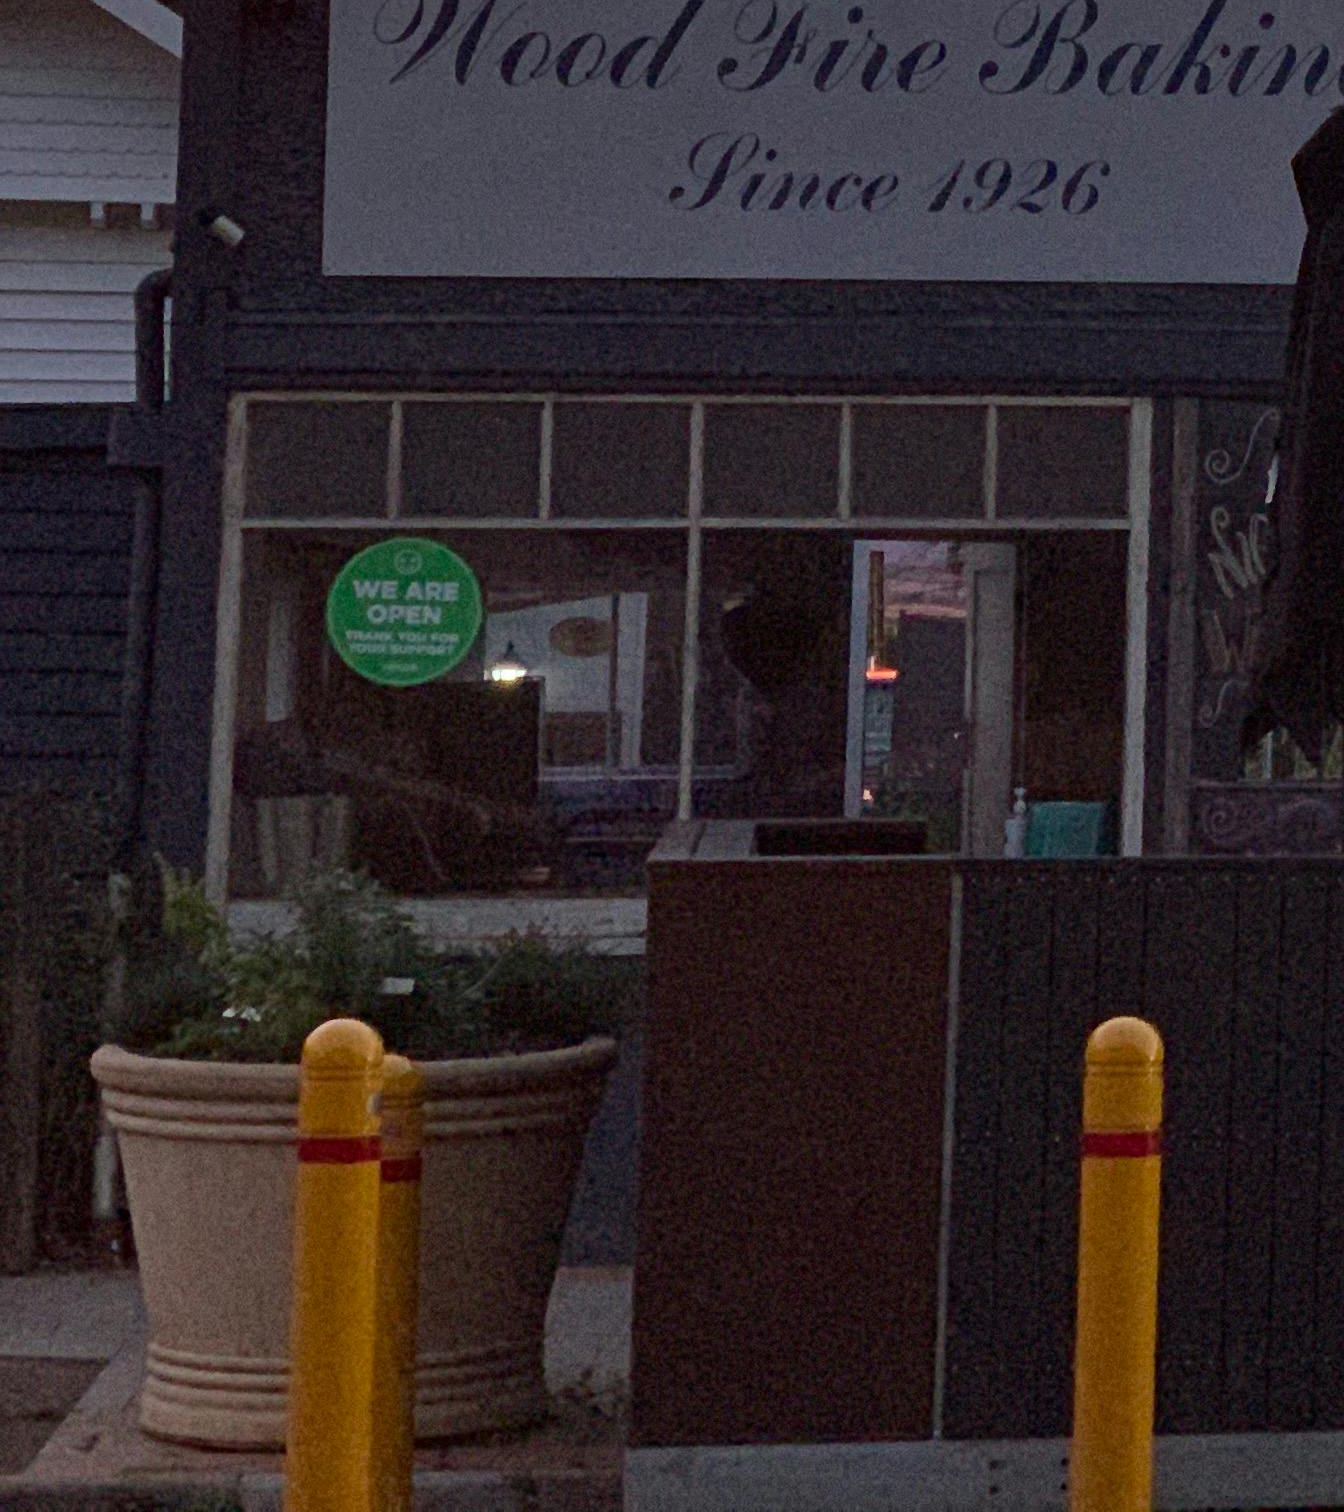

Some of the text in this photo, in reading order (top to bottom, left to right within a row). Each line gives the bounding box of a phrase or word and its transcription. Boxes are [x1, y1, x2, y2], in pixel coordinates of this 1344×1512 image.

[668, 131, 1109, 216] Since 1926
[353, 580, 459, 601] WE ARE
[367, 604, 442, 624] OPEN
[345, 630, 459, 643] THANK YOU FOR
[349, 643, 454, 656] YOUR SUPPORT
